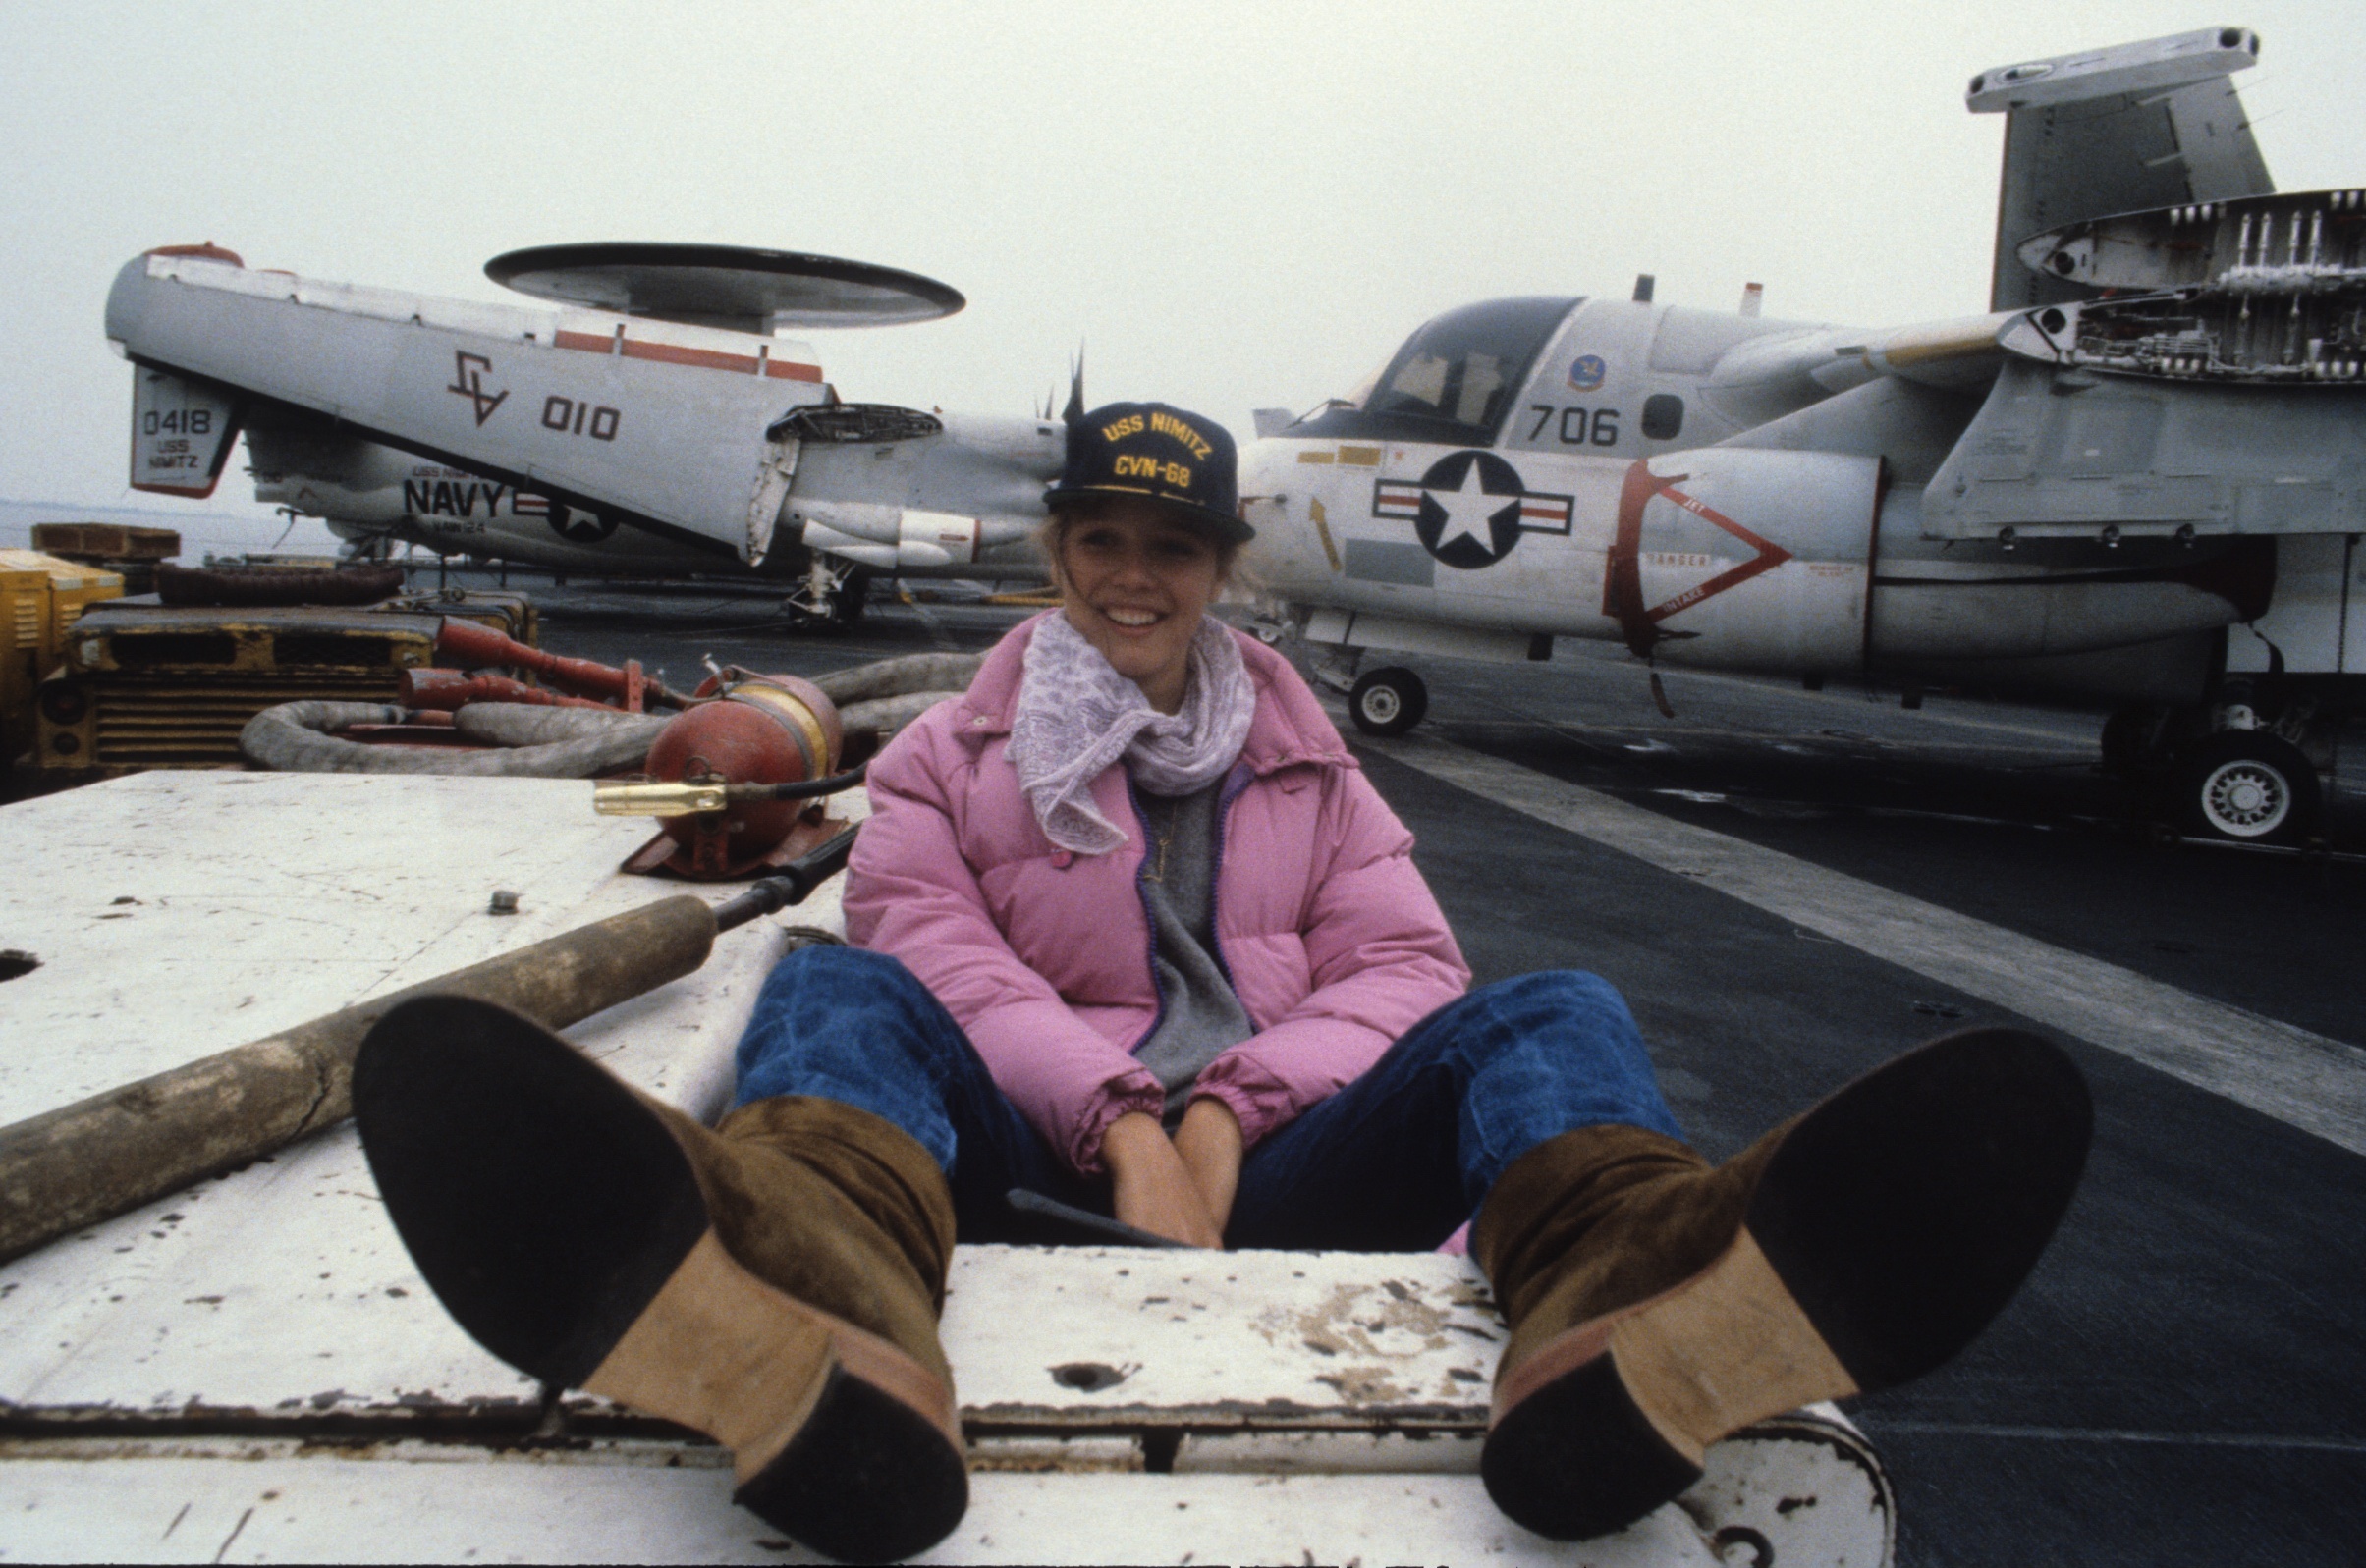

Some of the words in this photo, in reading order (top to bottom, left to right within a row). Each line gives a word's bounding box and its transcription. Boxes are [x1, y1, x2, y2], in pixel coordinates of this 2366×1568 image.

[143, 409, 211, 435] 0418
[541, 395, 621, 441] 010
[1528, 404, 1621, 446] 706
[158, 438, 190, 453] USS
[1102, 414, 1144, 442] USS
[1151, 411, 1213, 460] NIMITZ
[1114, 455, 1191, 488] CVN-68
[404, 479, 505, 517] NAVY
[1682, 498, 1706, 514] JET
[1661, 586, 1706, 613] INTAKE
